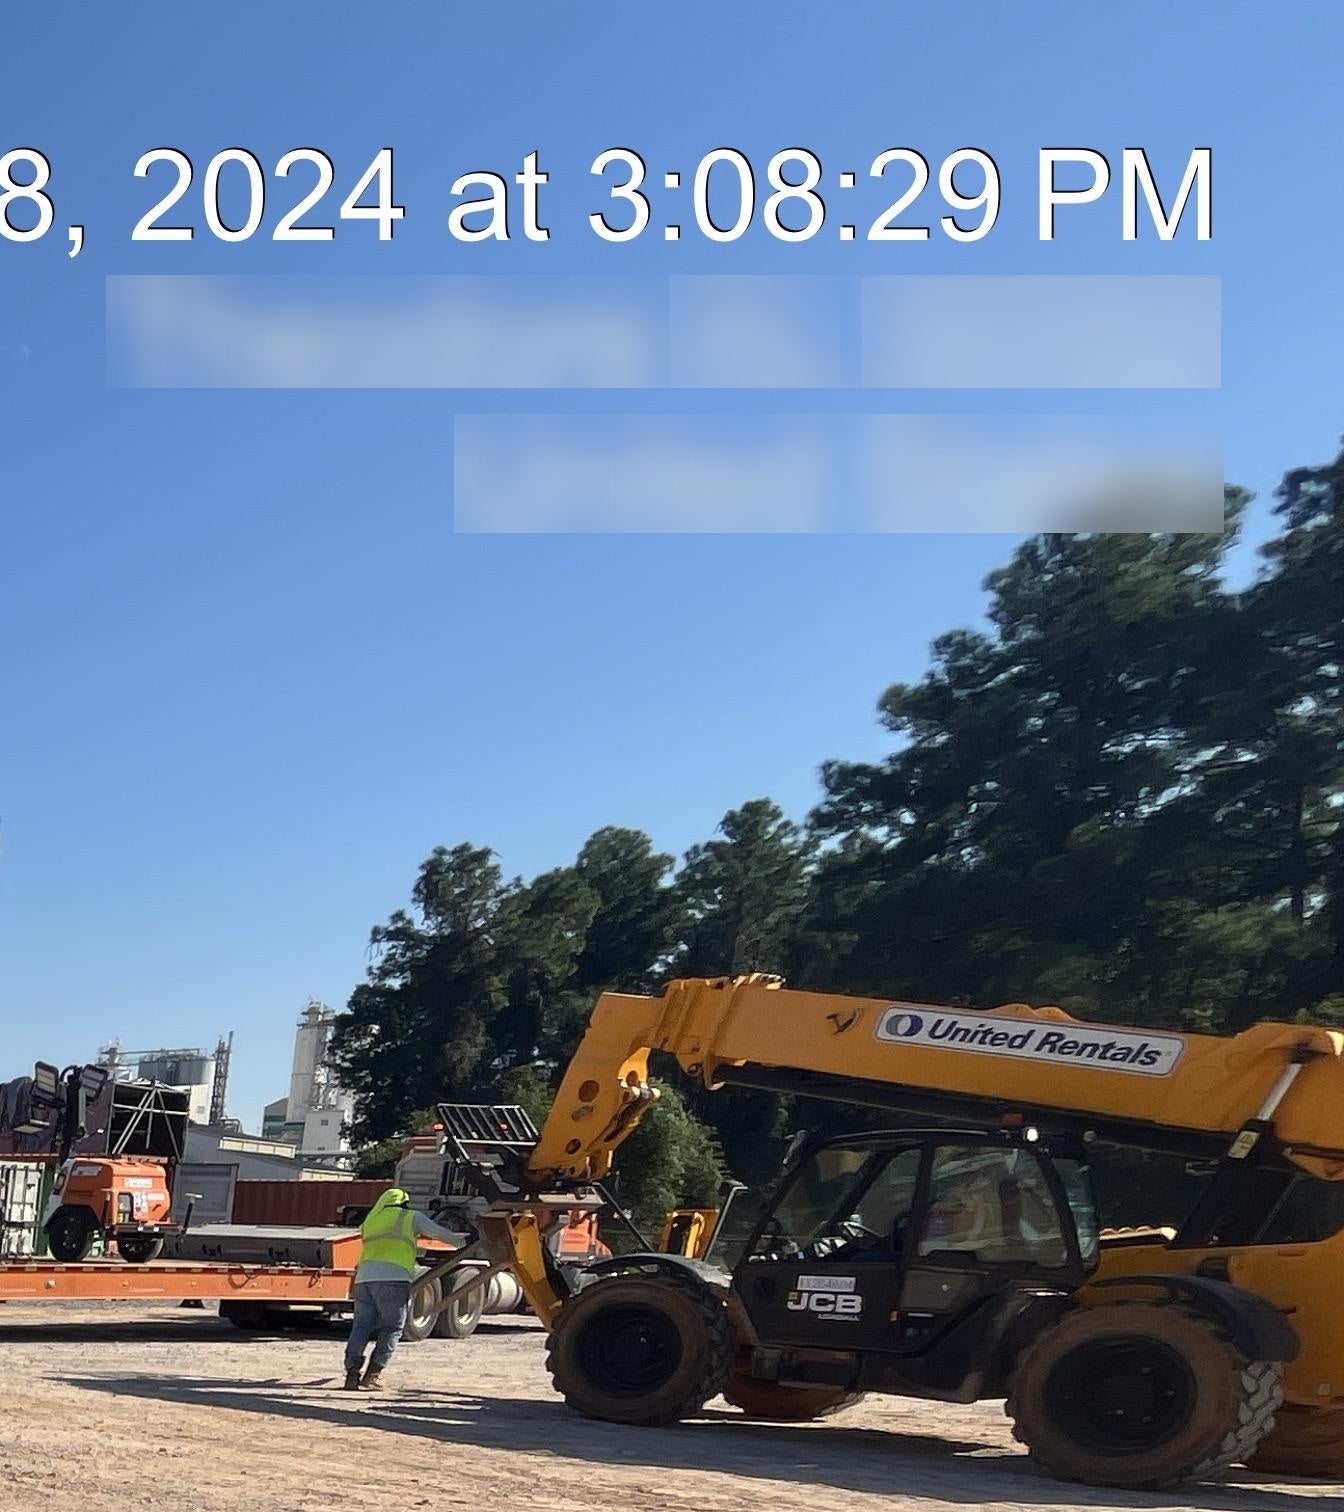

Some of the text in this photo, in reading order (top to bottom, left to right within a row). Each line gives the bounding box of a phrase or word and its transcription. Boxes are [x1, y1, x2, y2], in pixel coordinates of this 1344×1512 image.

[928, 1018, 1163, 1067] United Rentals
[786, 1291, 864, 1314] JCB
